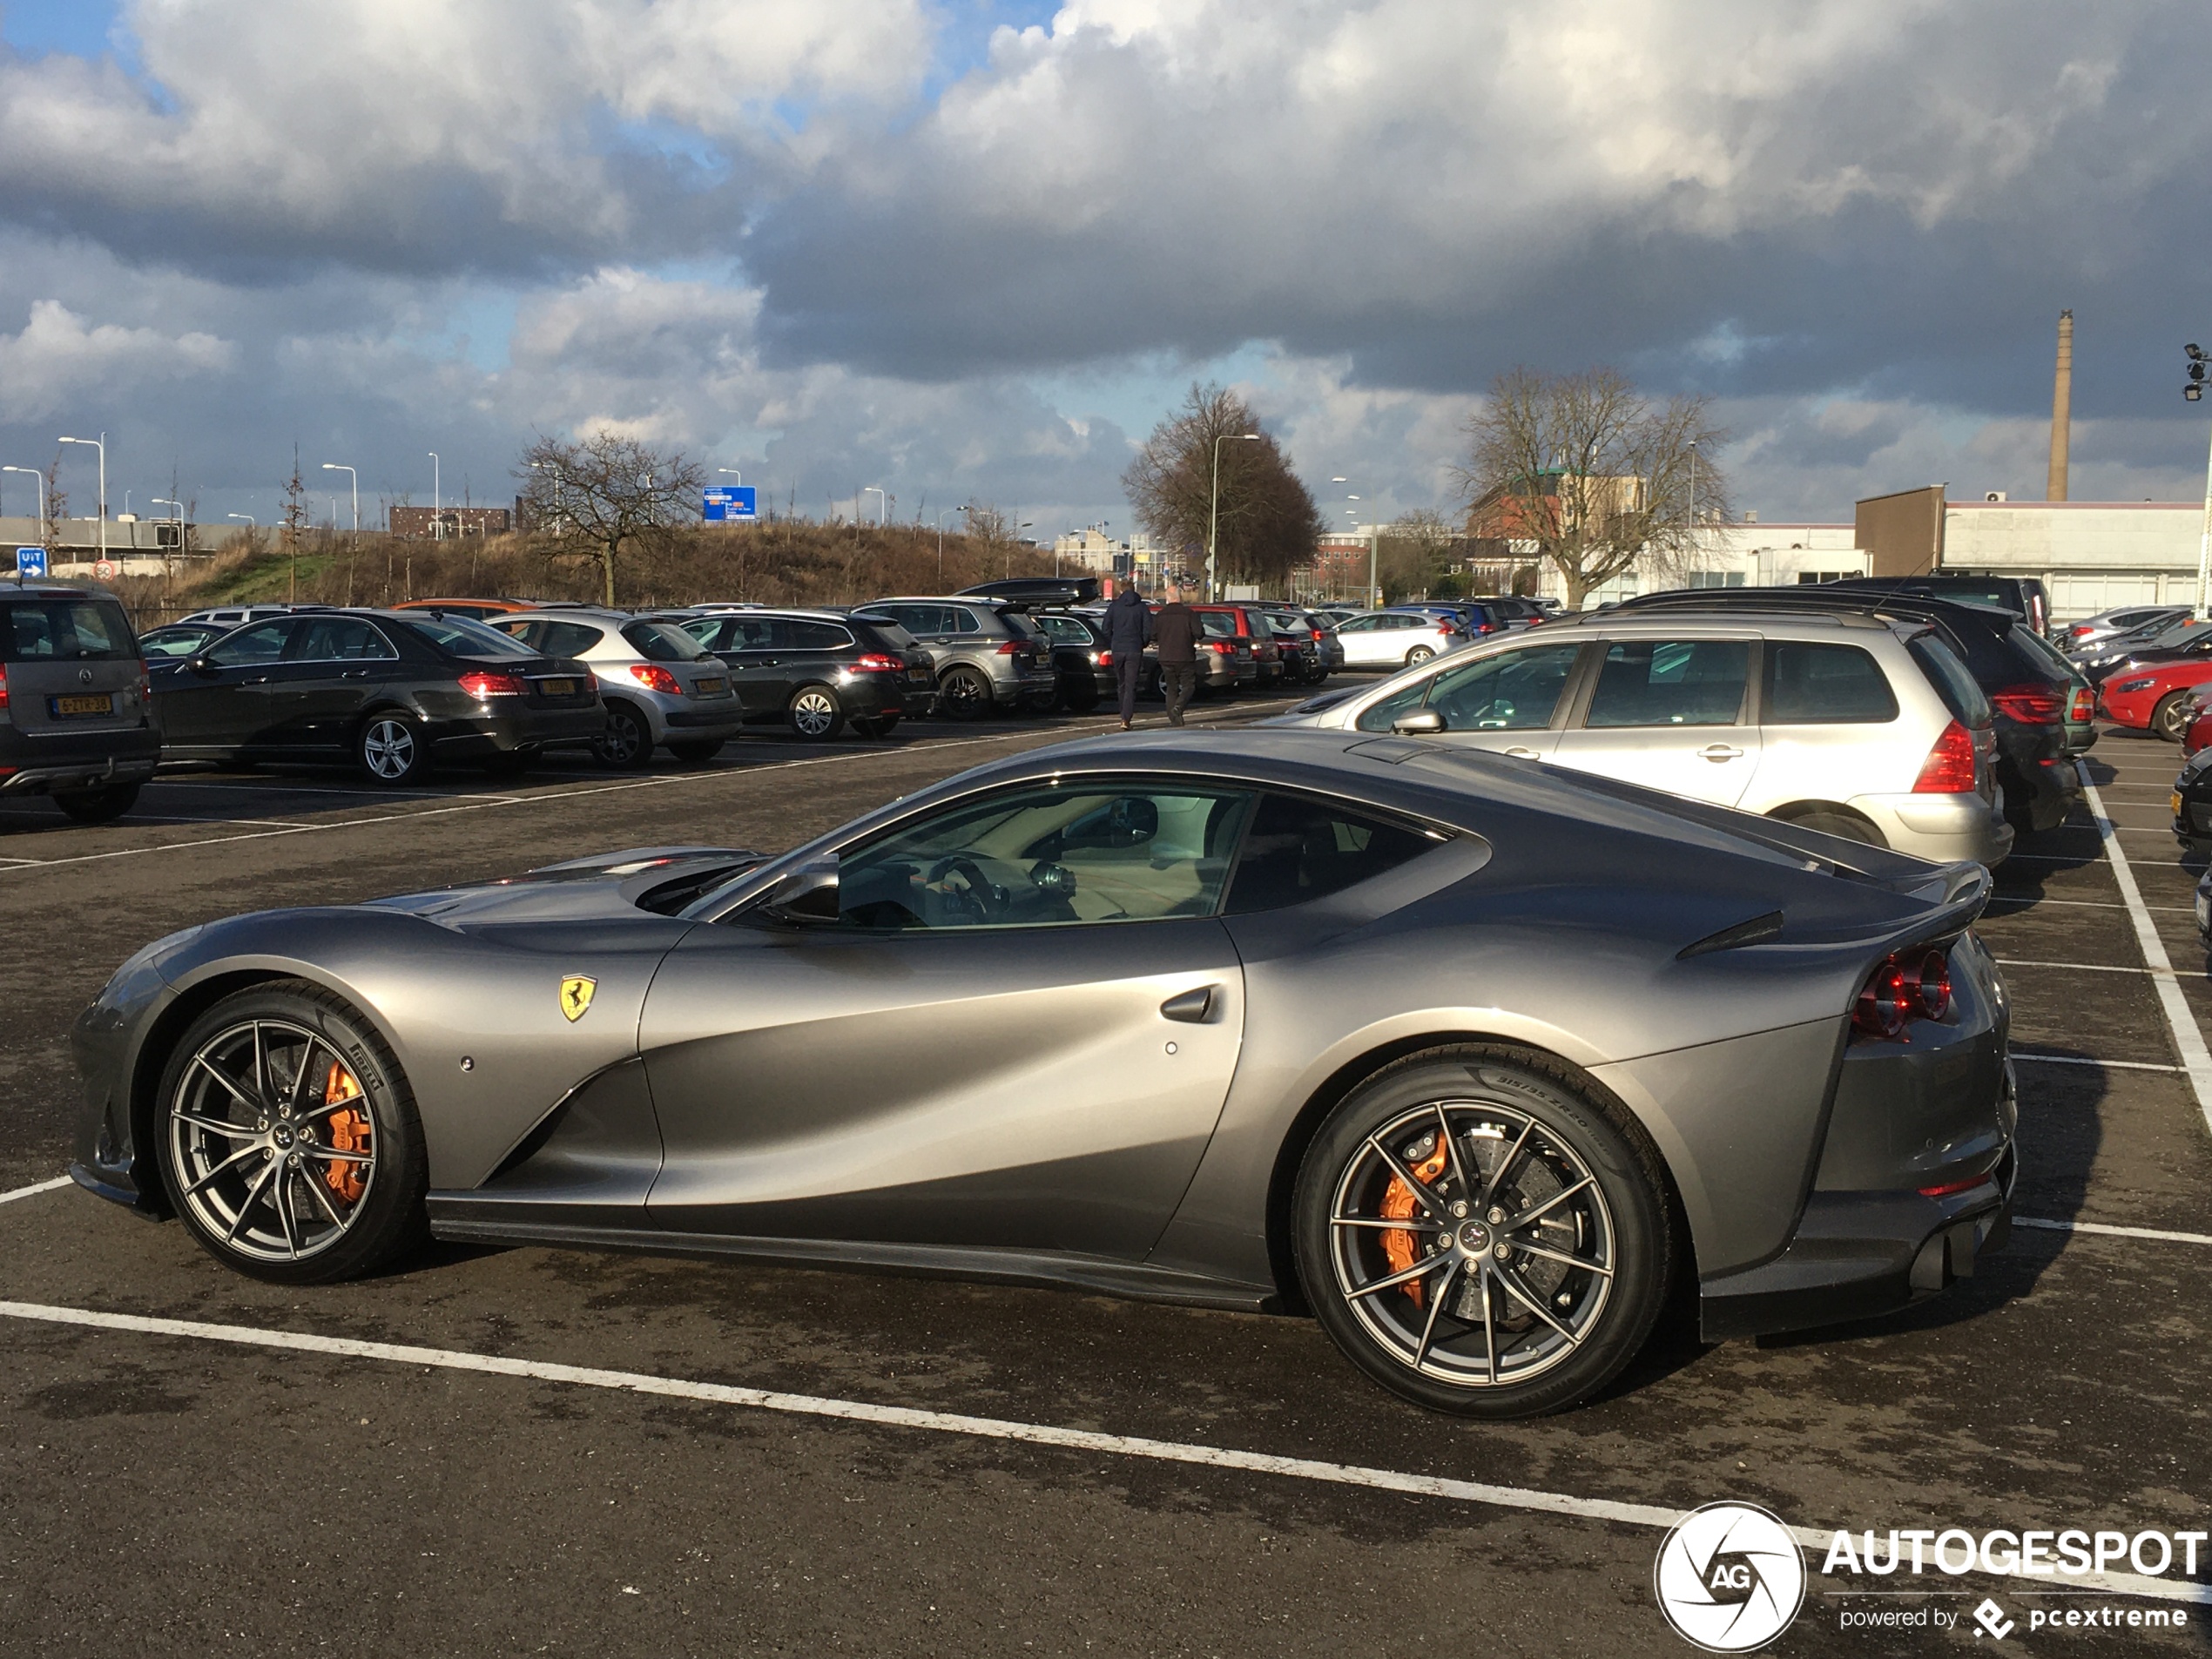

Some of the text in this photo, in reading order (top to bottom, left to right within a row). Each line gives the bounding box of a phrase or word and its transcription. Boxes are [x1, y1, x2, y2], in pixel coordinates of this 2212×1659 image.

[97, 567, 112, 576] 50
[348, 1043, 384, 1090] PIRELLI
[1496, 1076, 1548, 1098] 315/35
[1548, 1098, 1588, 1128] ZR20
